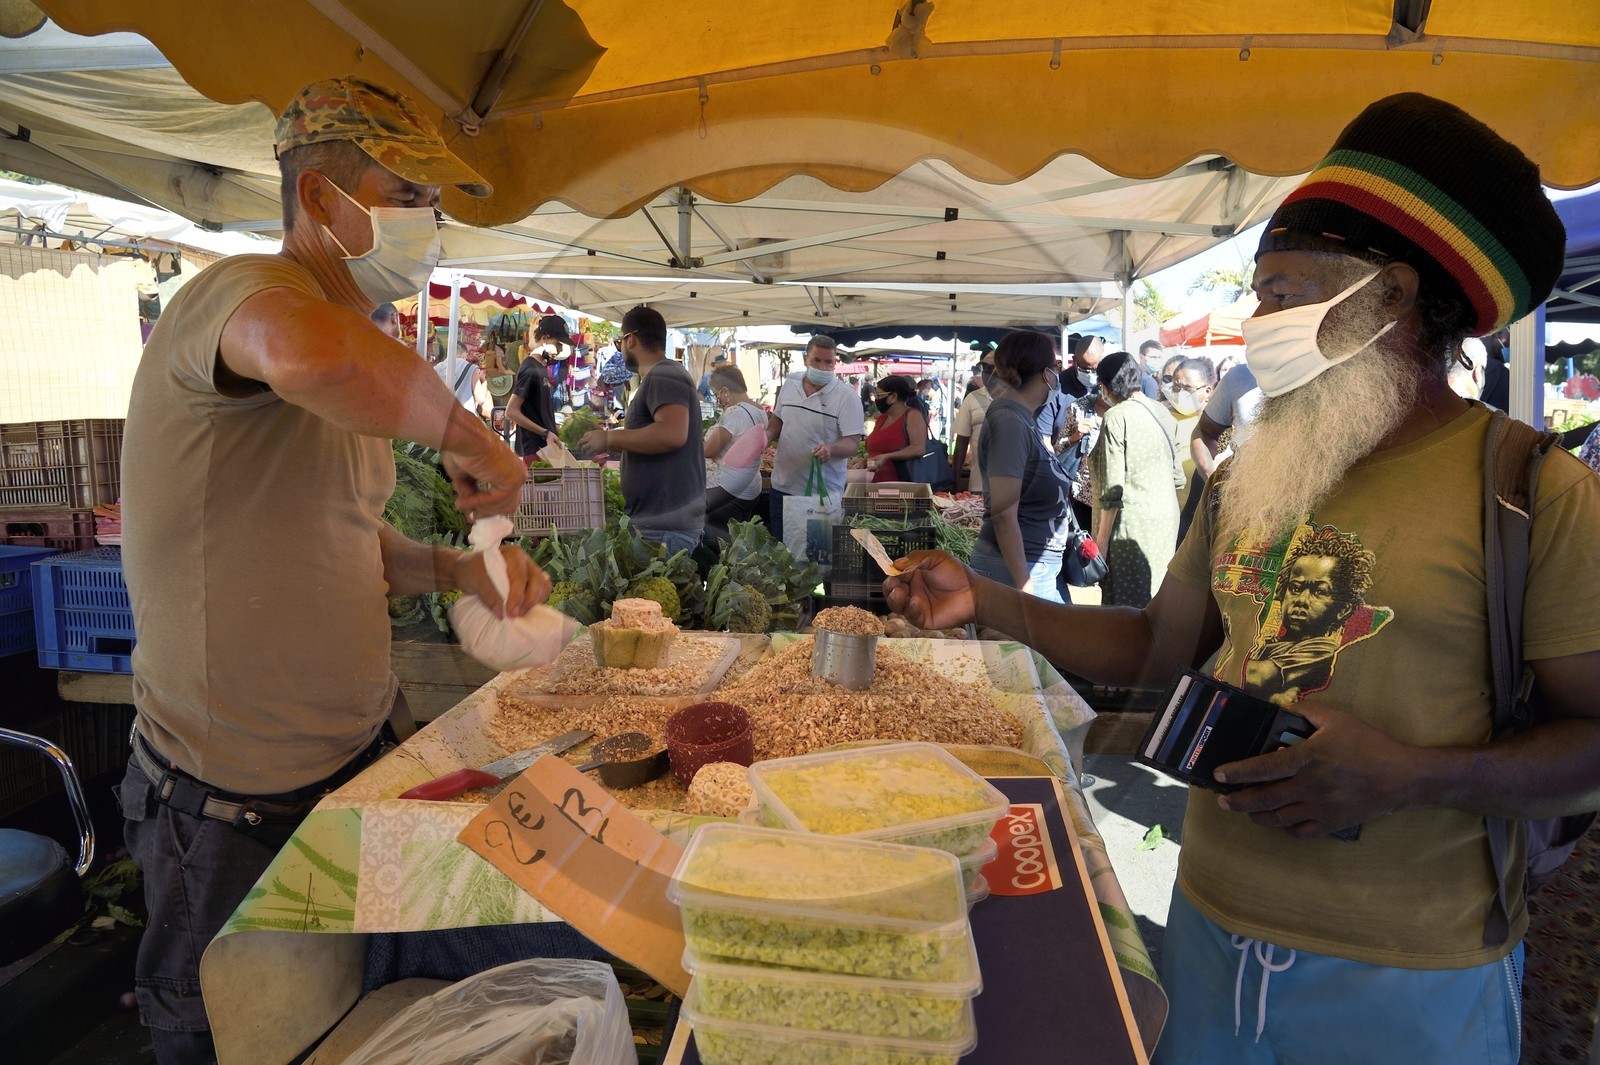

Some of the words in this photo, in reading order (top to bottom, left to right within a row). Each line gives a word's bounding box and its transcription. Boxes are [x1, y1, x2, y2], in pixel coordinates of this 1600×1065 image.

[1237, 553, 1279, 572] NATION
[1190, 728, 1211, 763] INTERSPORT
[1006, 811, 1046, 889] Coopex
